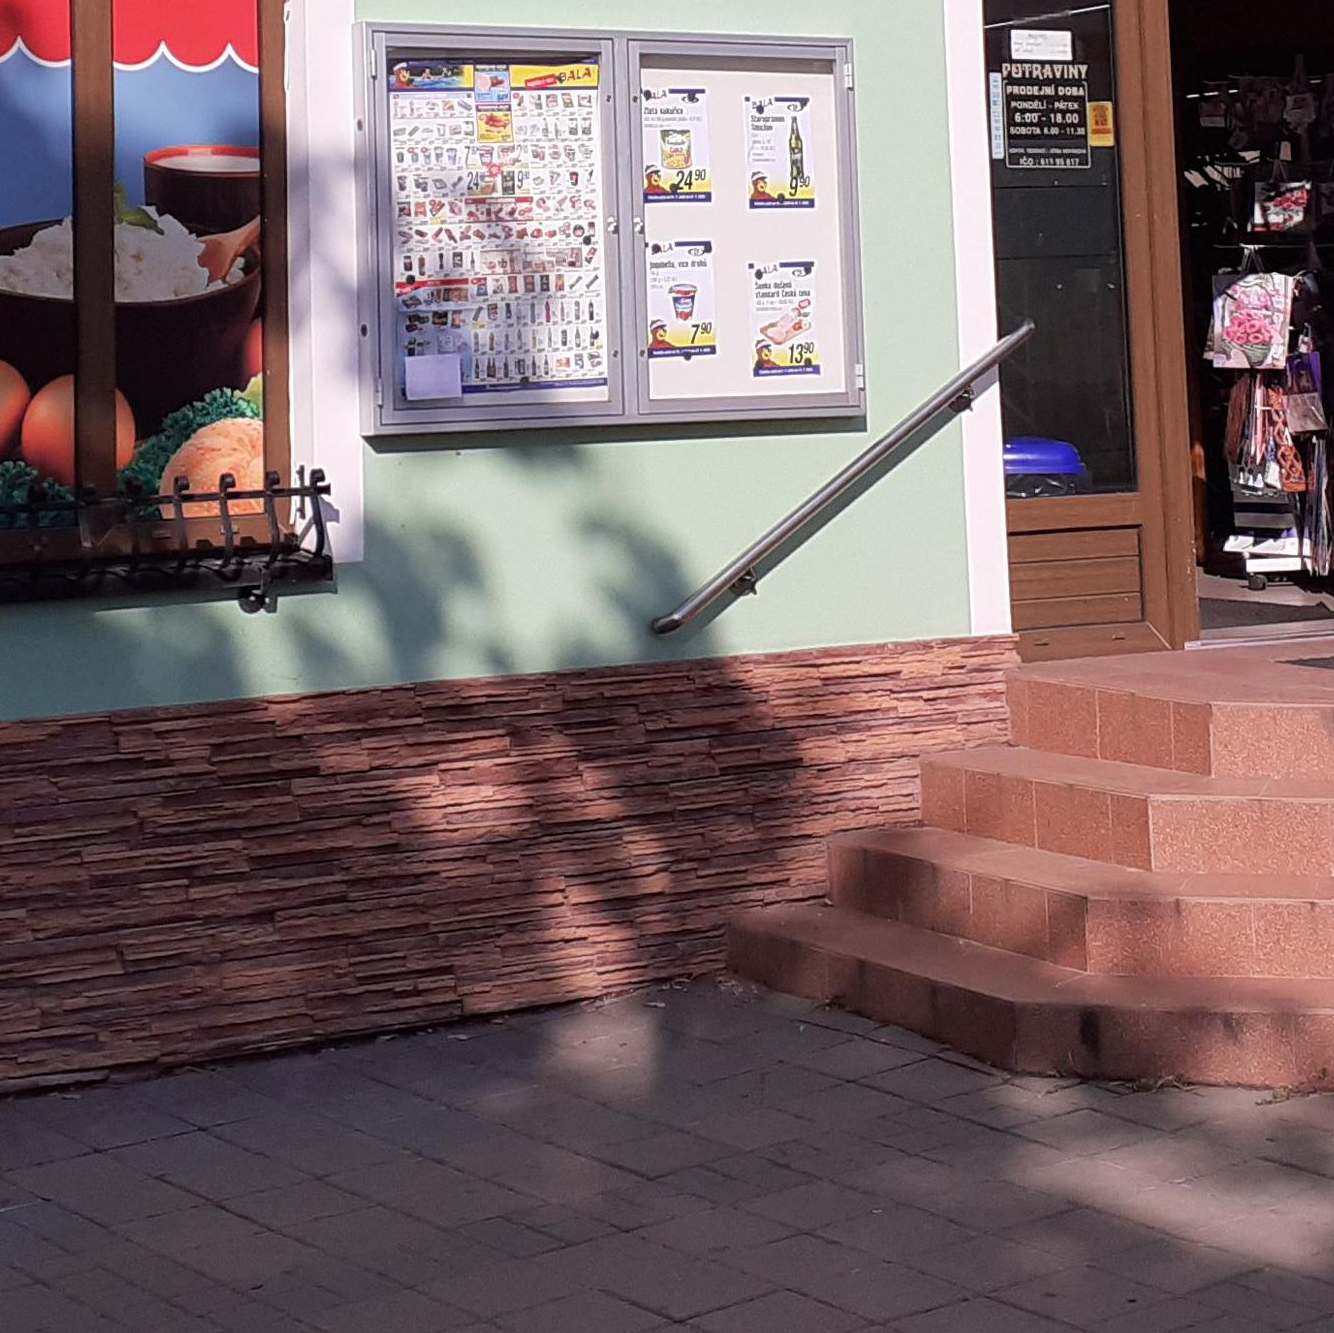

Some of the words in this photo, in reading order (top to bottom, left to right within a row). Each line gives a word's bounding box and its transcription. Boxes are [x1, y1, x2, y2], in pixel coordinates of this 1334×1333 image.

[1002, 63, 1088, 79] POTRAVINY
[1007, 84, 1055, 96] PRODEJNÍ
[1058, 86, 1085, 96] DOBA
[1010, 100, 1047, 109] PONDĚLÍ
[1050, 114, 1079, 124] 18.00
[1009, 126, 1041, 135] SOBOTA
